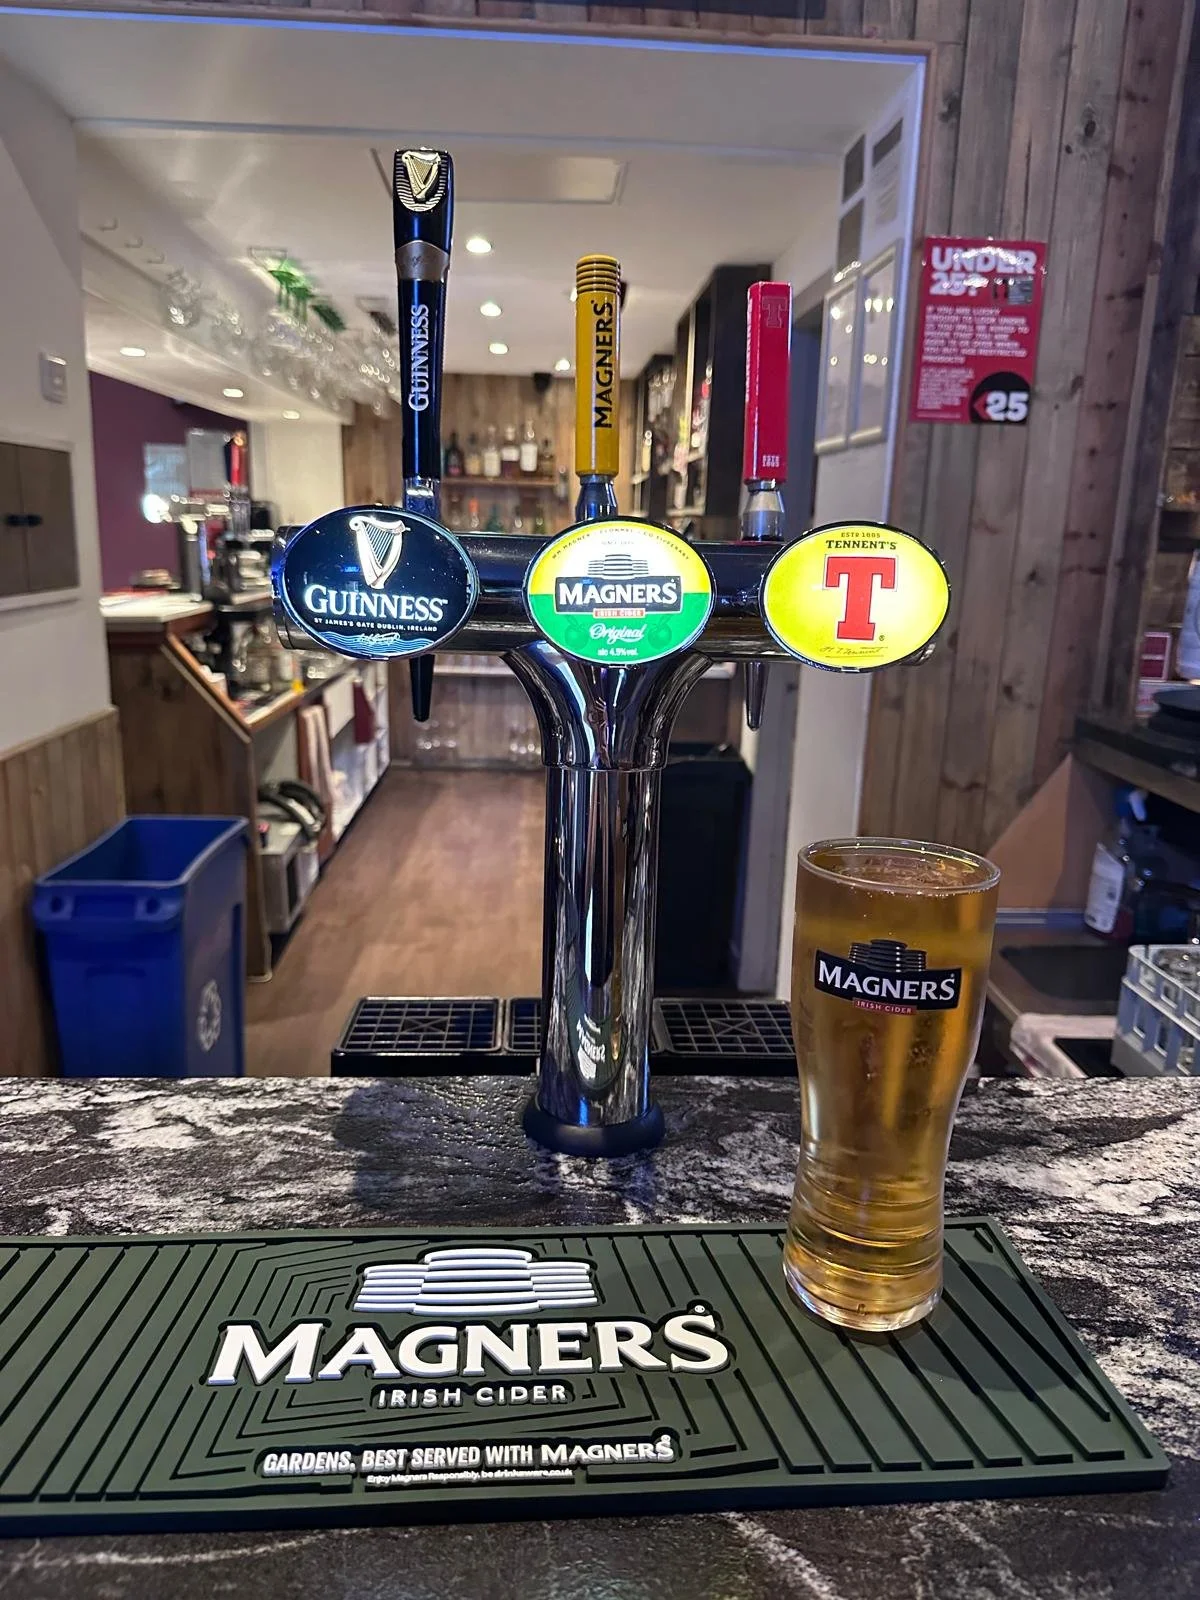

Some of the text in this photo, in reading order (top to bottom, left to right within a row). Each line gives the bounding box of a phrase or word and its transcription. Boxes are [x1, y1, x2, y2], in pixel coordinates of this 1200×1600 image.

[931, 246, 1037, 275] UNDER
[408, 304, 429, 411] GUINNESS
[592, 300, 614, 429] MAGNERS
[985, 390, 1029, 422] 25
[825, 540, 897, 550] TENNENT'S
[559, 580, 679, 606] MAGNERS
[825, 556, 896, 641] T
[325, 618, 354, 627] JAMES'S
[356, 621, 375, 629] GATE
[407, 625, 438, 633] IRELAND
[589, 623, 648, 645] Original
[818, 959, 955, 1001] MAGNERS
[856, 1000, 912, 1014] IRISH CIDER
[206, 1304, 730, 1386] MAGNERS
[378, 1385, 567, 1408] IRISH CIDER
[263, 1434, 675, 1475] GARDENS. BEST SERVED WITH MAGNERS
[366, 1475, 391, 1484] Enjoy
[391, 1473, 428, 1484] Magners
[481, 1470, 494, 1478] be
